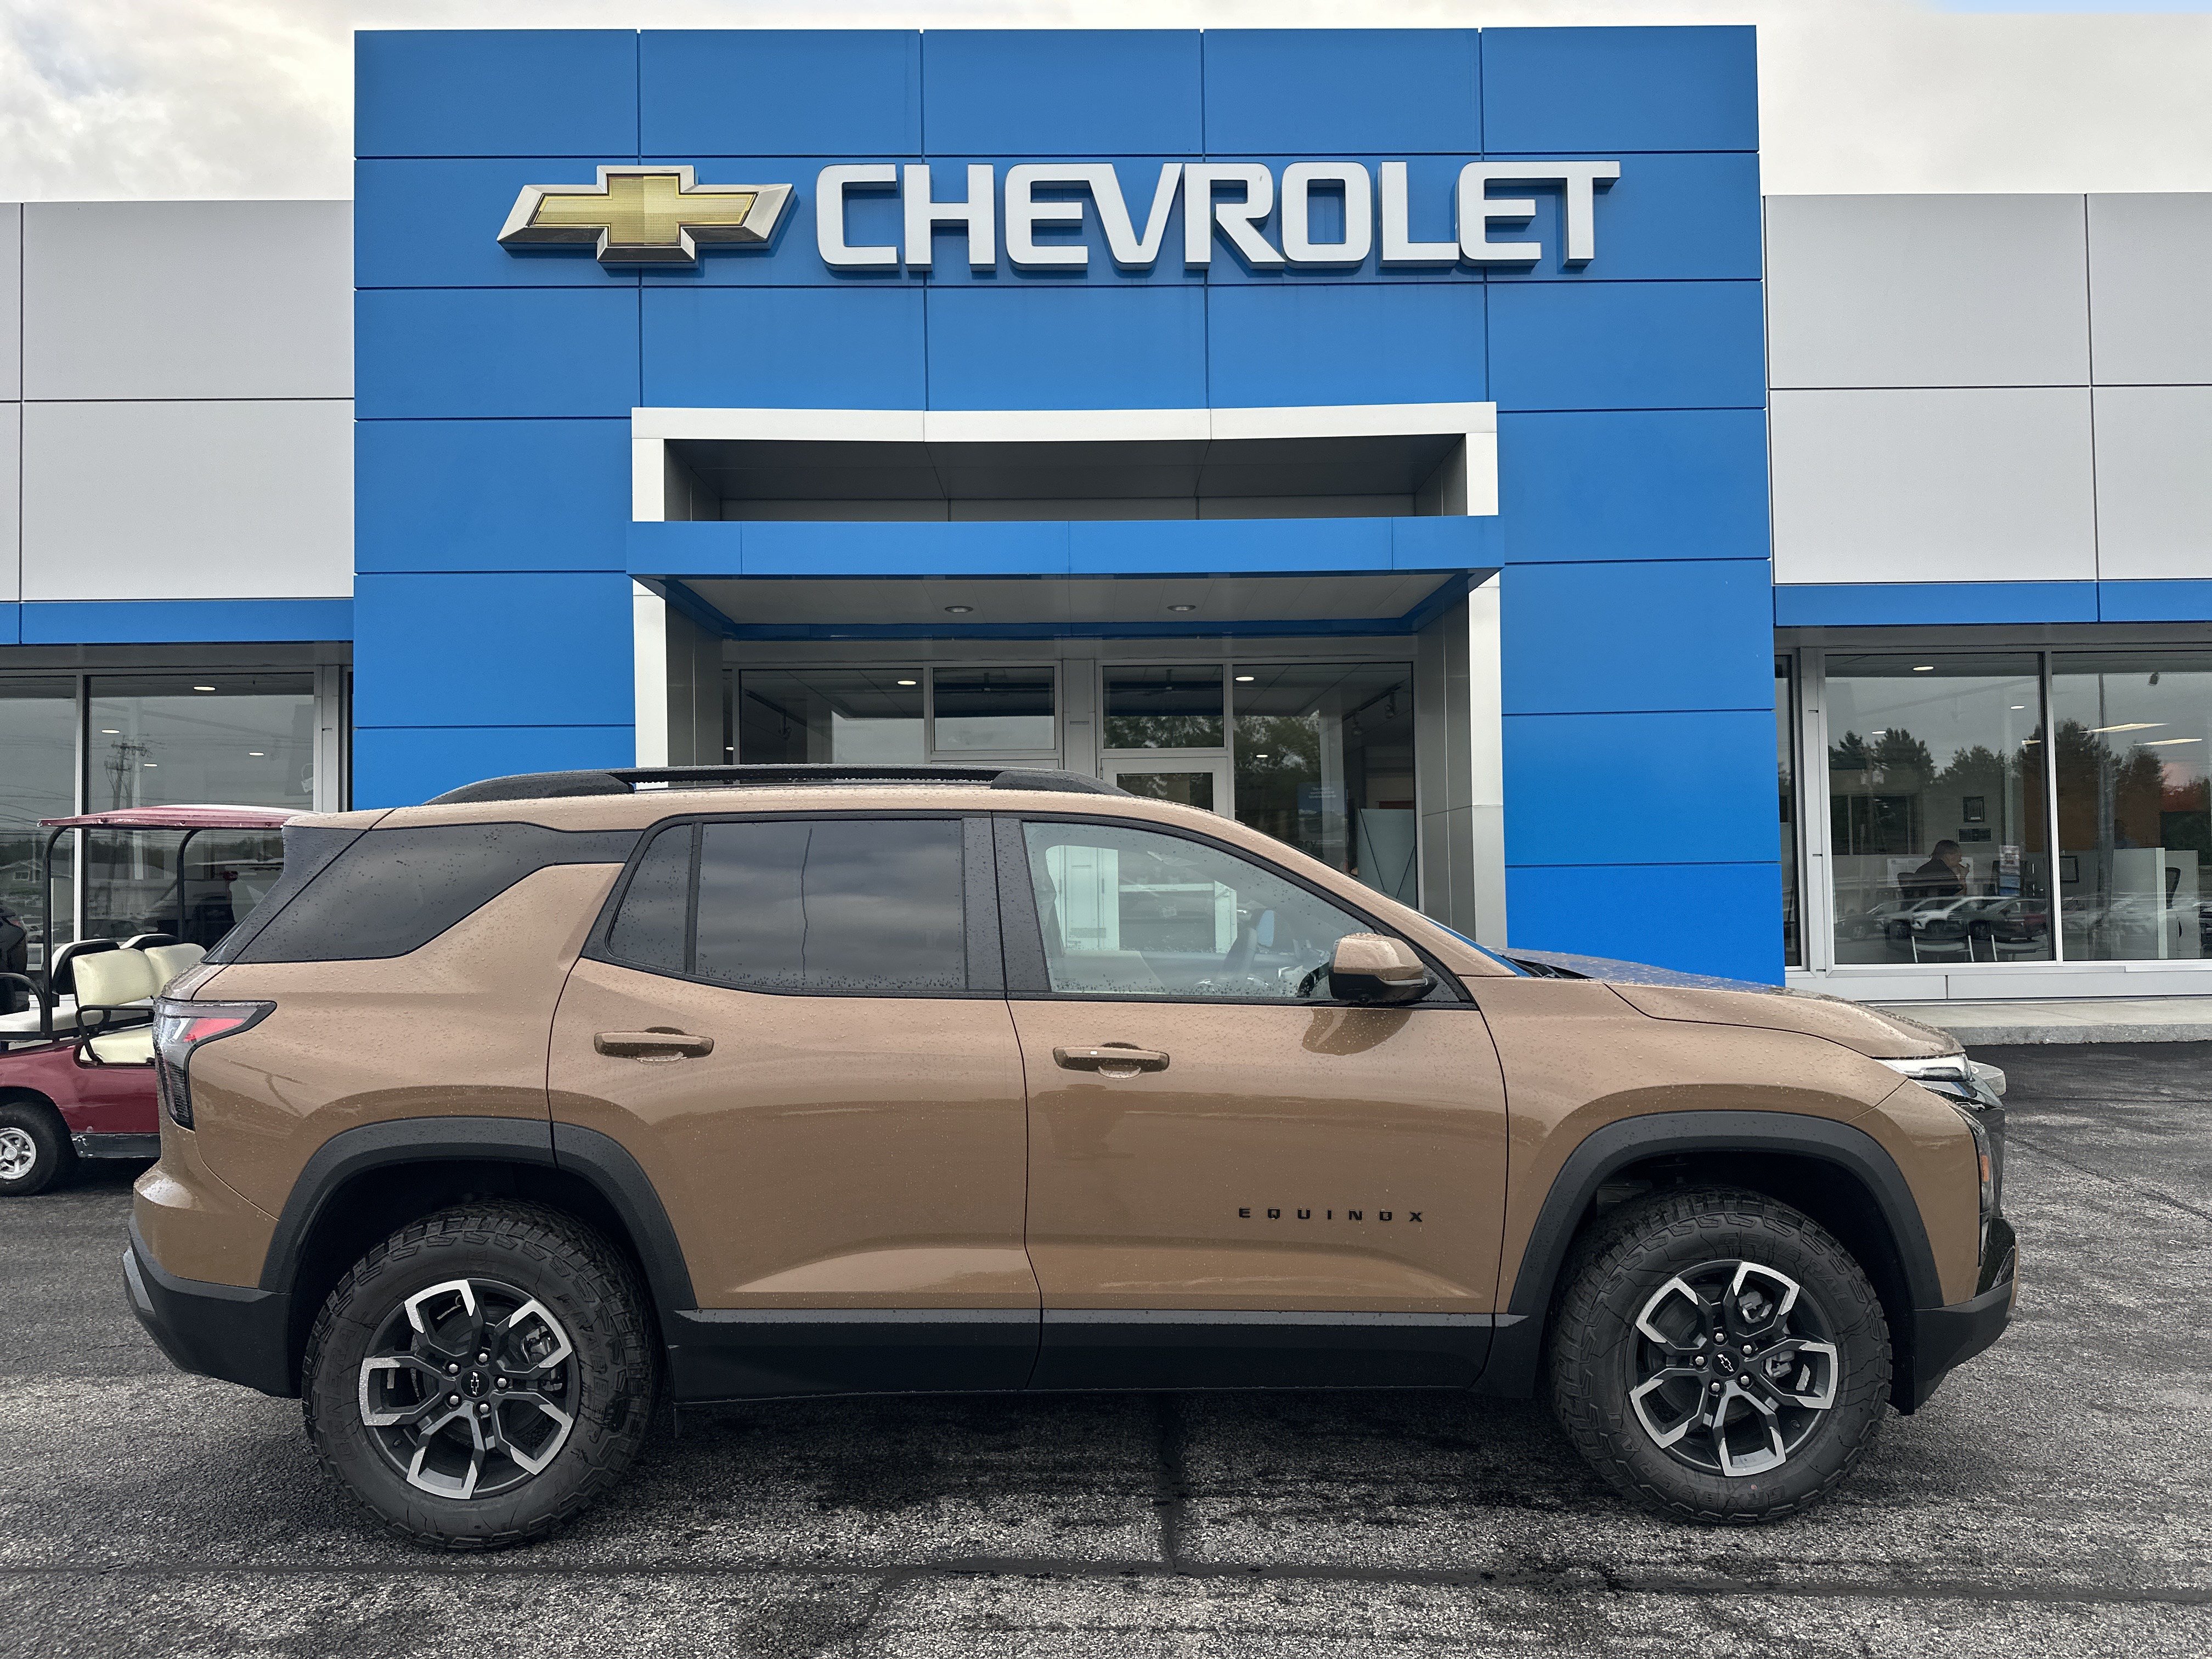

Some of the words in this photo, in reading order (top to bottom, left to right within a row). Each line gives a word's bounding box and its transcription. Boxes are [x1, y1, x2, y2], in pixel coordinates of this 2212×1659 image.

[816, 161, 1621, 272] CHEVROLET
[1239, 1207, 1423, 1222] EQUINOX
[1718, 1232, 1848, 1311] GENERAL
[325, 1310, 368, 1462] GENERAL
[554, 1291, 610, 1443] GRABBER
[1638, 1460, 1787, 1510] GRABBER
